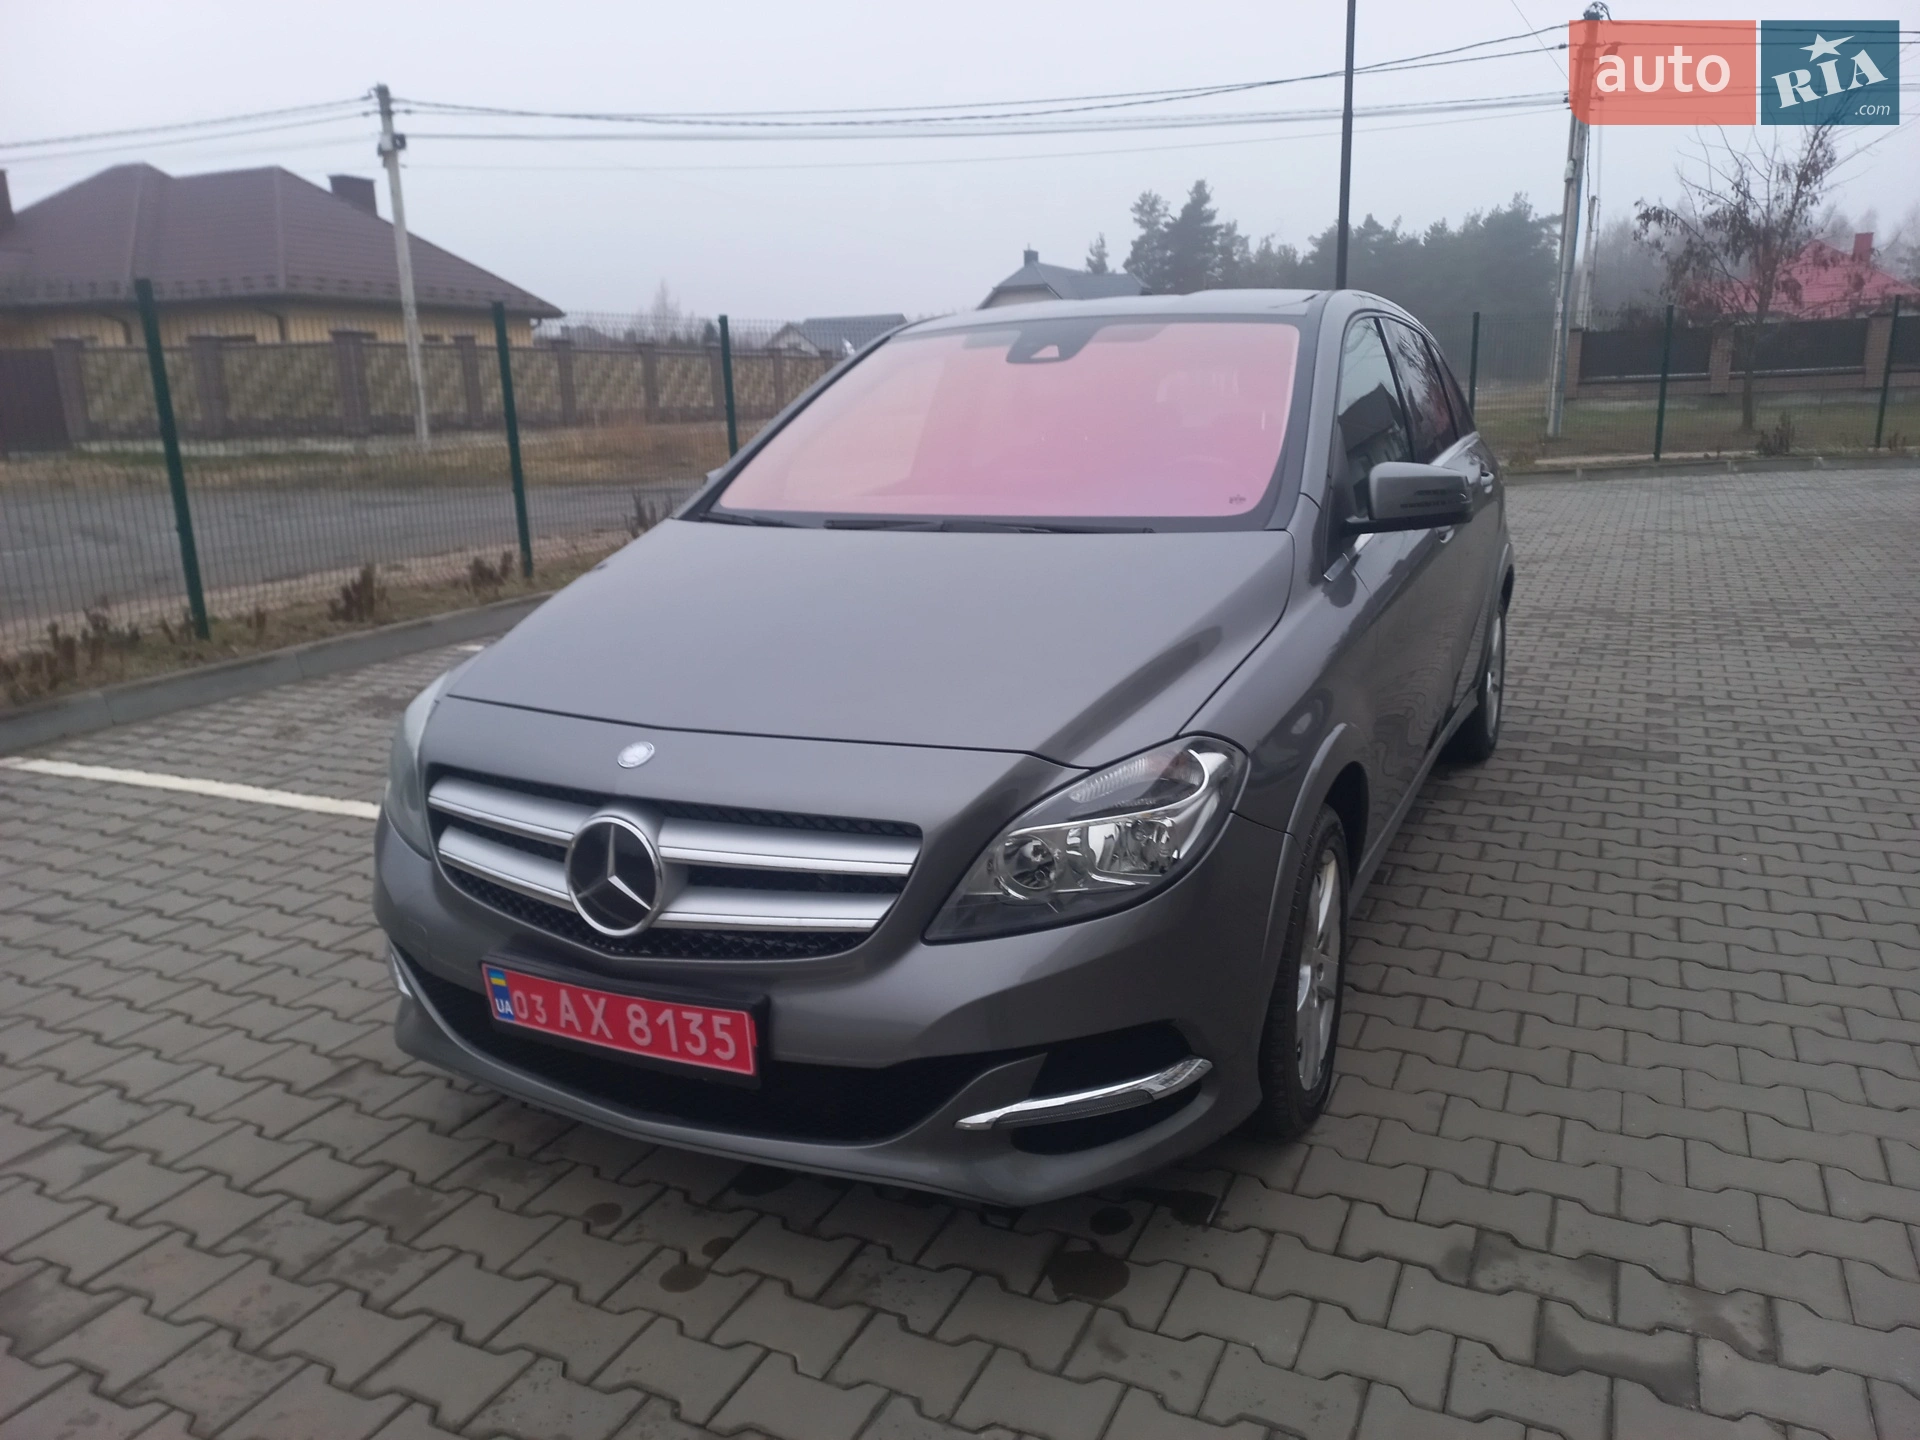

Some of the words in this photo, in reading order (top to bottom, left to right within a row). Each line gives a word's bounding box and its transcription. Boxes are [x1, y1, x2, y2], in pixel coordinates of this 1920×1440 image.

[494, 998, 514, 1016] UA
[513, 990, 547, 1024] 03
[559, 988, 613, 1040] AX
[626, 1003, 736, 1061] 8135
